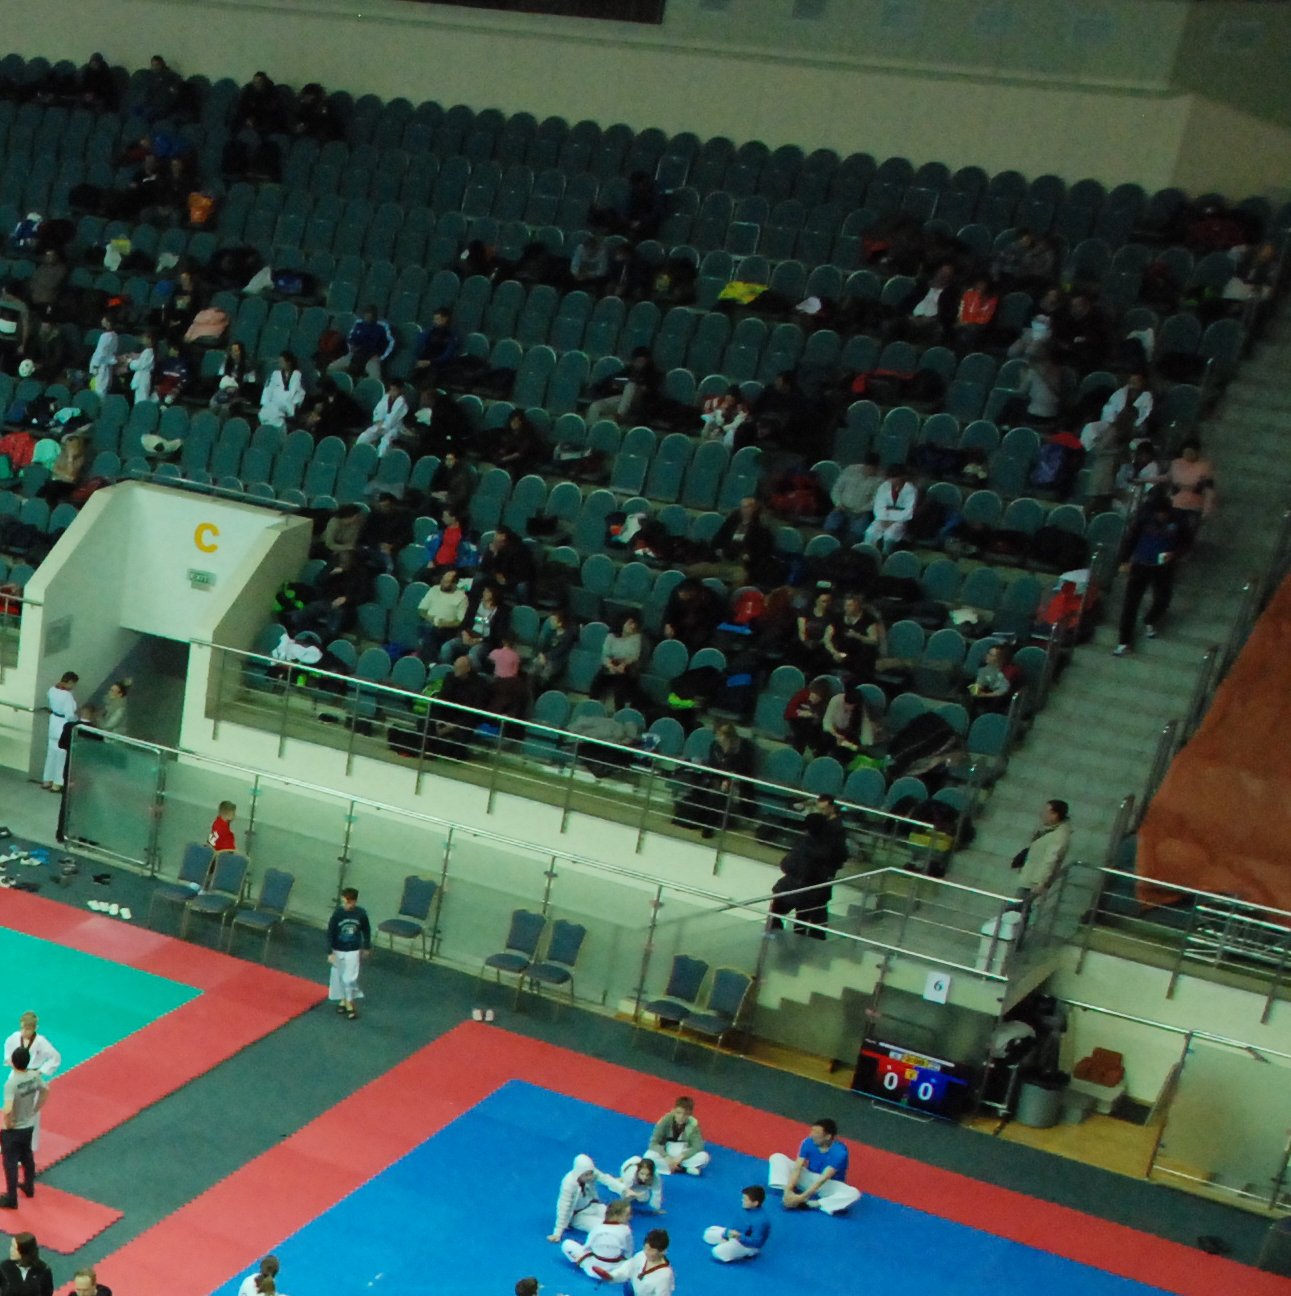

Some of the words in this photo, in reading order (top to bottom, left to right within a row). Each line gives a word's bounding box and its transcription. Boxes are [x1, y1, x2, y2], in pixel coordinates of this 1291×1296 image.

[194, 523, 219, 553] C
[933, 980, 944, 992] 6
[884, 1072, 898, 1090] 0
[918, 1082, 933, 1100] 0
